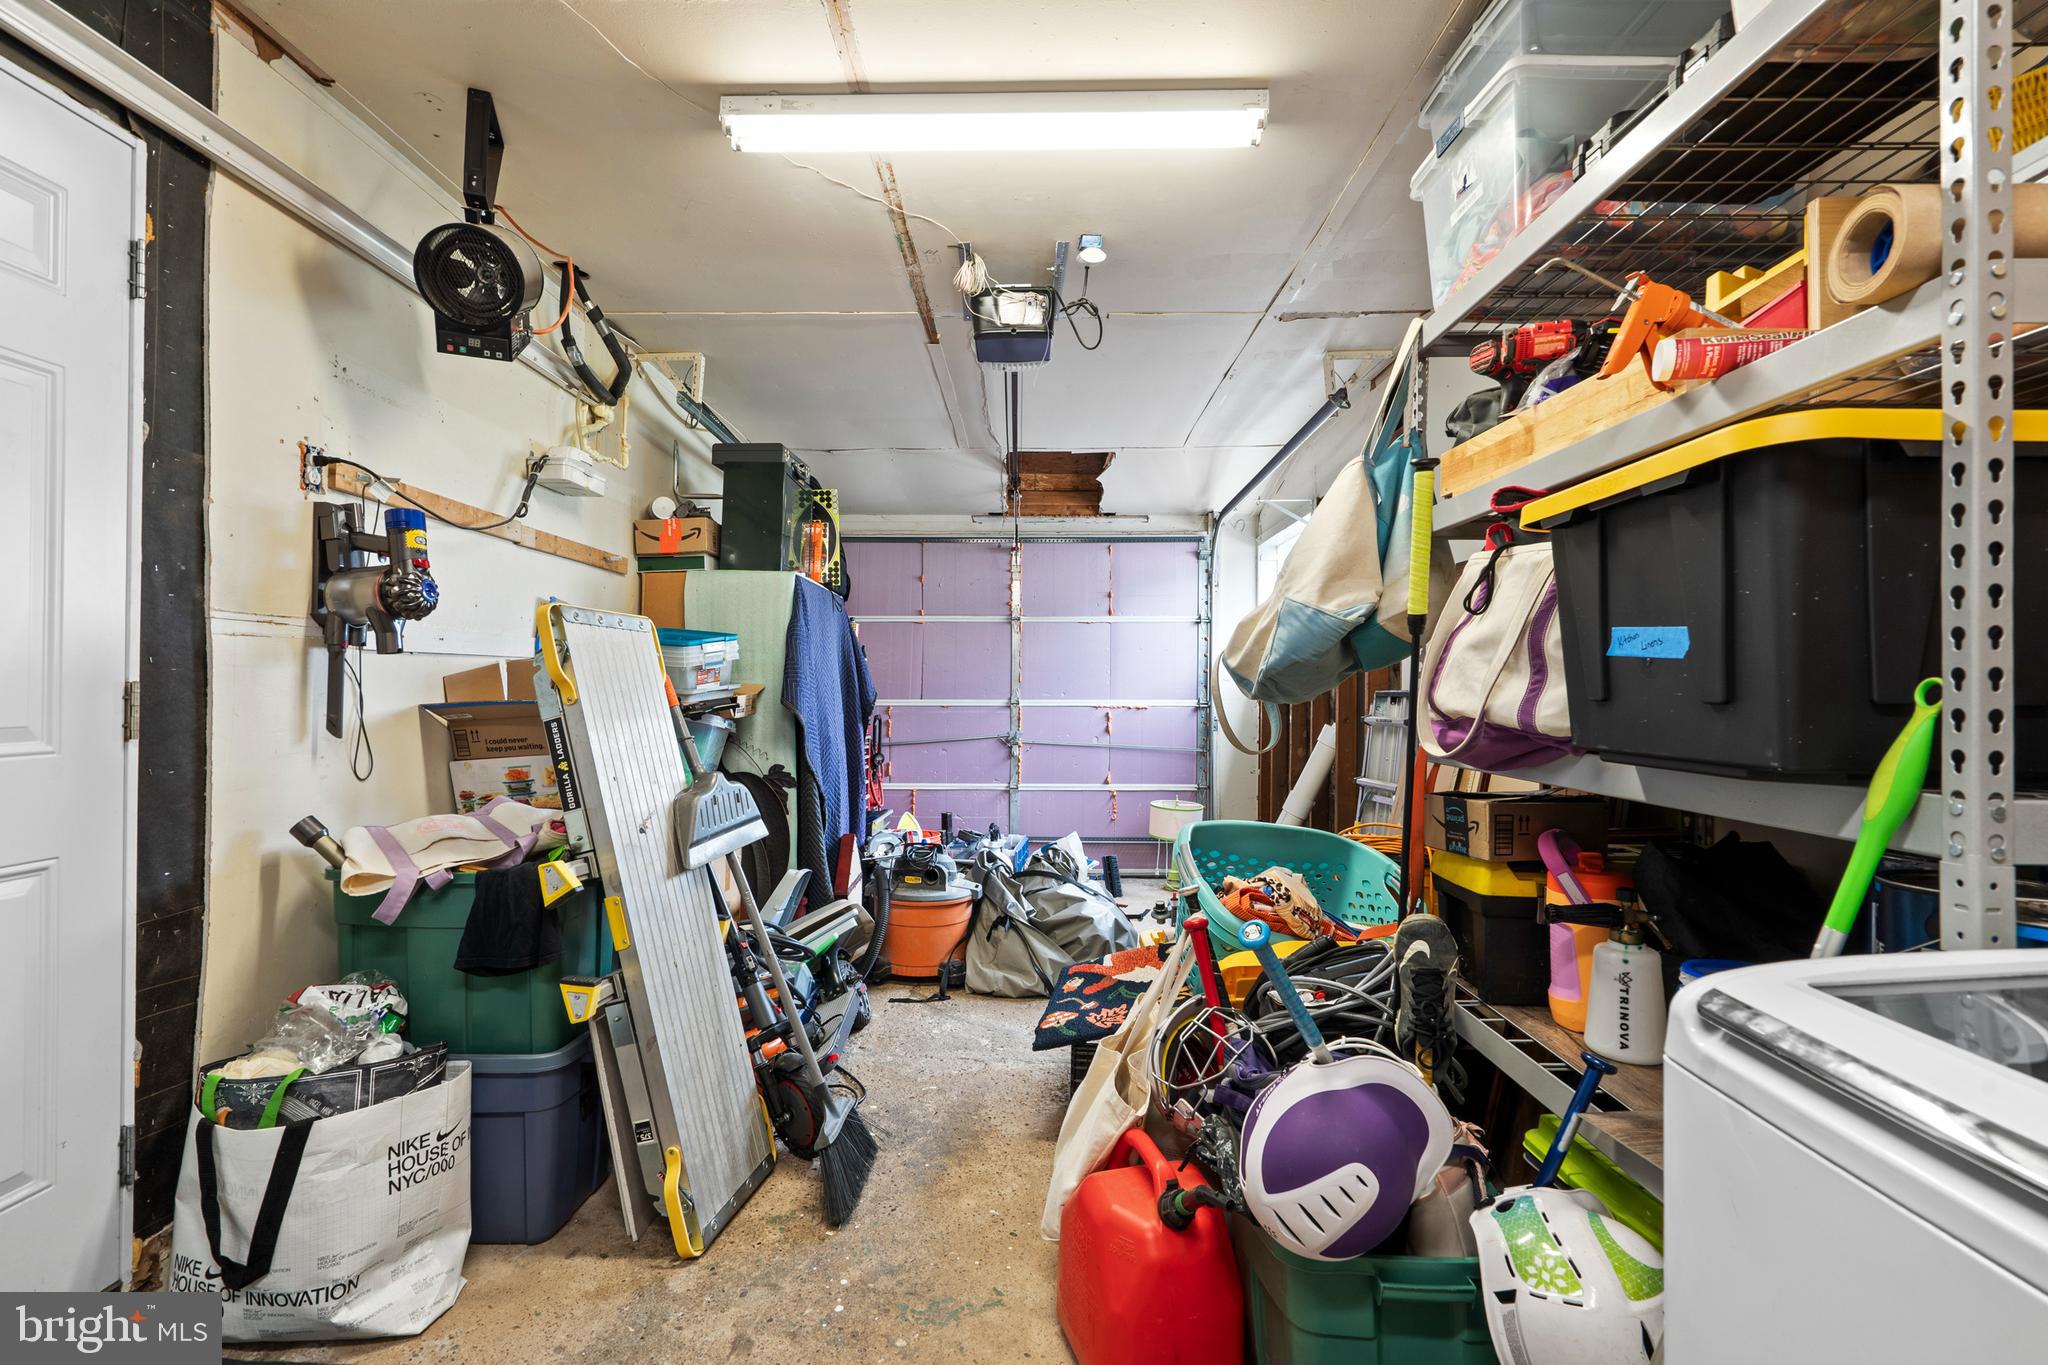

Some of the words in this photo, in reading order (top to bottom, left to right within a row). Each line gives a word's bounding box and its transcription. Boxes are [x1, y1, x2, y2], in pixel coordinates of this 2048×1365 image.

[1702, 334, 1747, 344] Kwik
[486, 745, 503, 753] keep
[503, 745, 517, 753] you
[517, 742, 545, 752] waiting.
[488, 737, 507, 745] could
[550, 721, 565, 760] LADDERS
[563, 773, 576, 809] GORILLA
[1619, 987, 1630, 1050] TRINOVA
[388, 1132, 431, 1161] NIKE
[388, 1141, 449, 1178] HOUSE
[452, 1130, 467, 1152] OF
[388, 1155, 456, 1196] NYC/000
[174, 1253, 203, 1278] NIKE
[172, 1271, 216, 1292] HOUSE
[220, 1287, 242, 1304] OF
[245, 1274, 361, 1308] INNOVATION
